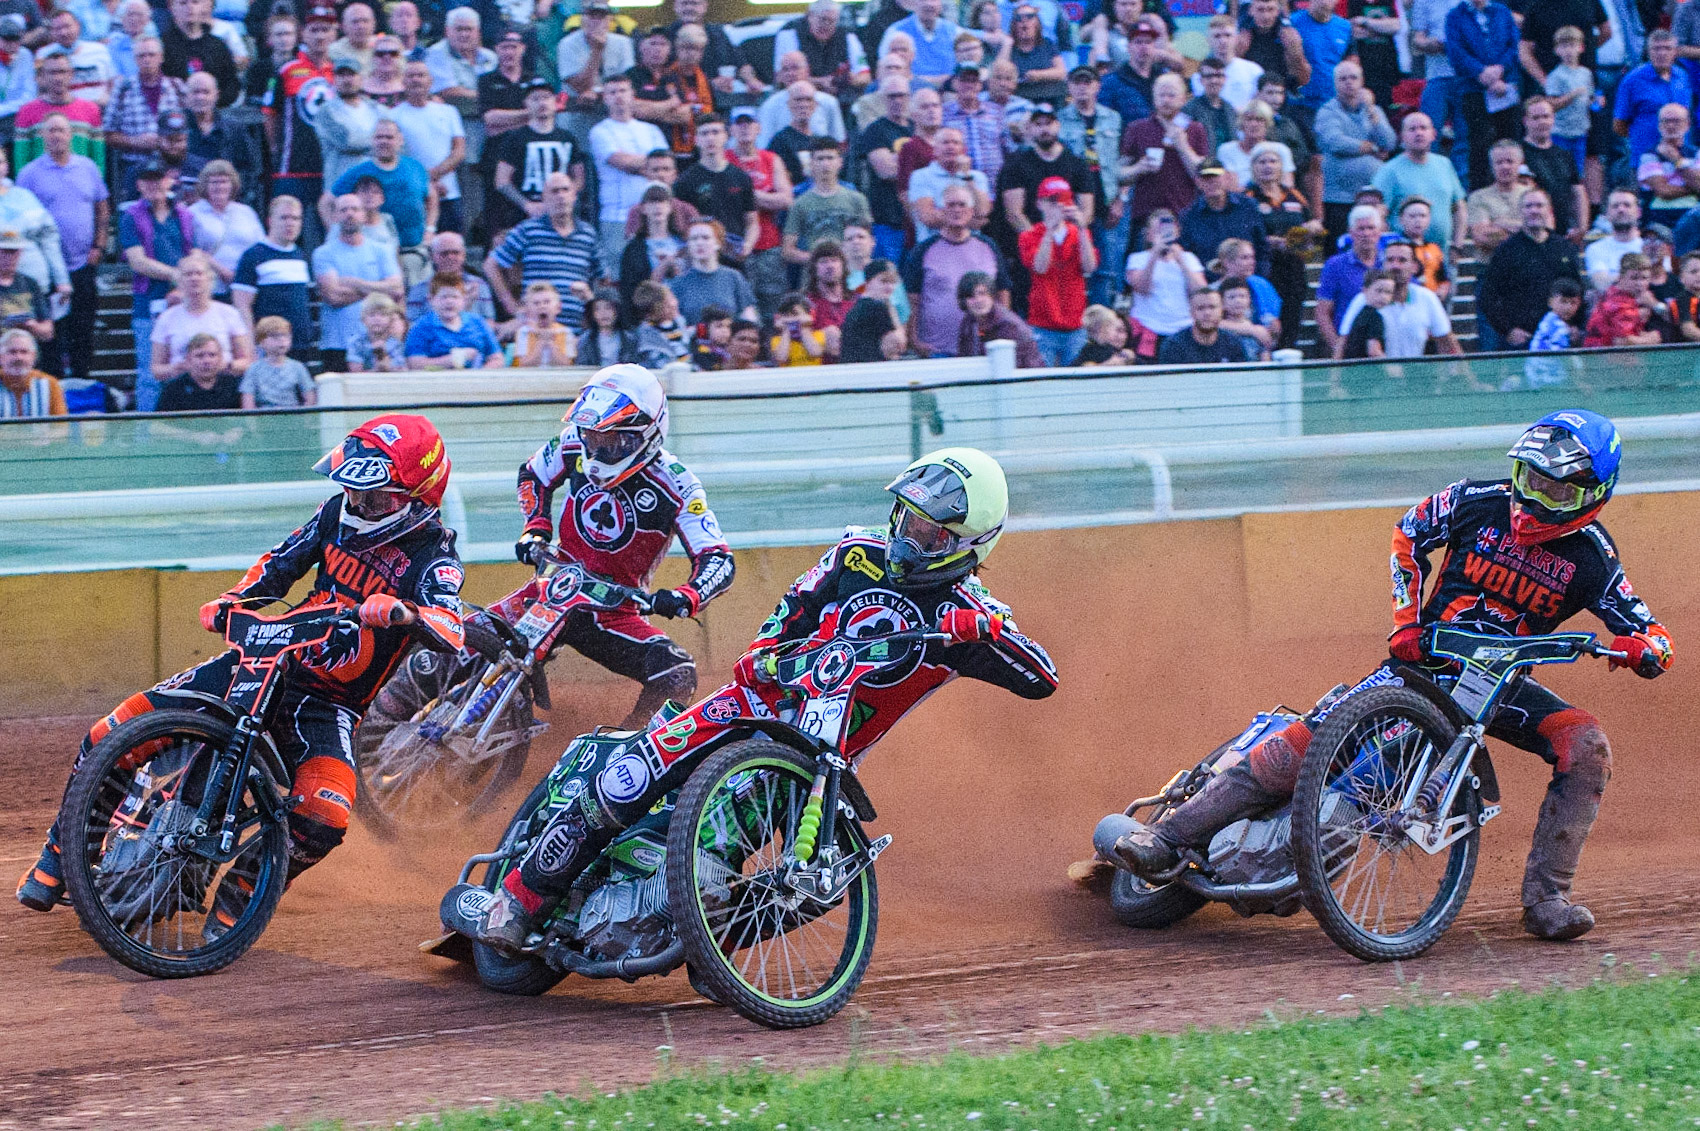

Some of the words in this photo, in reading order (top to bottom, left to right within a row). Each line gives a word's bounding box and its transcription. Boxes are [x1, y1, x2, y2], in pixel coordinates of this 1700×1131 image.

[1463, 551, 1564, 618] WOLVES
[850, 595, 886, 612] BELLE
[890, 597, 913, 619] VUE
[231, 682, 262, 692] JWP
[614, 763, 636, 792] ATPI
